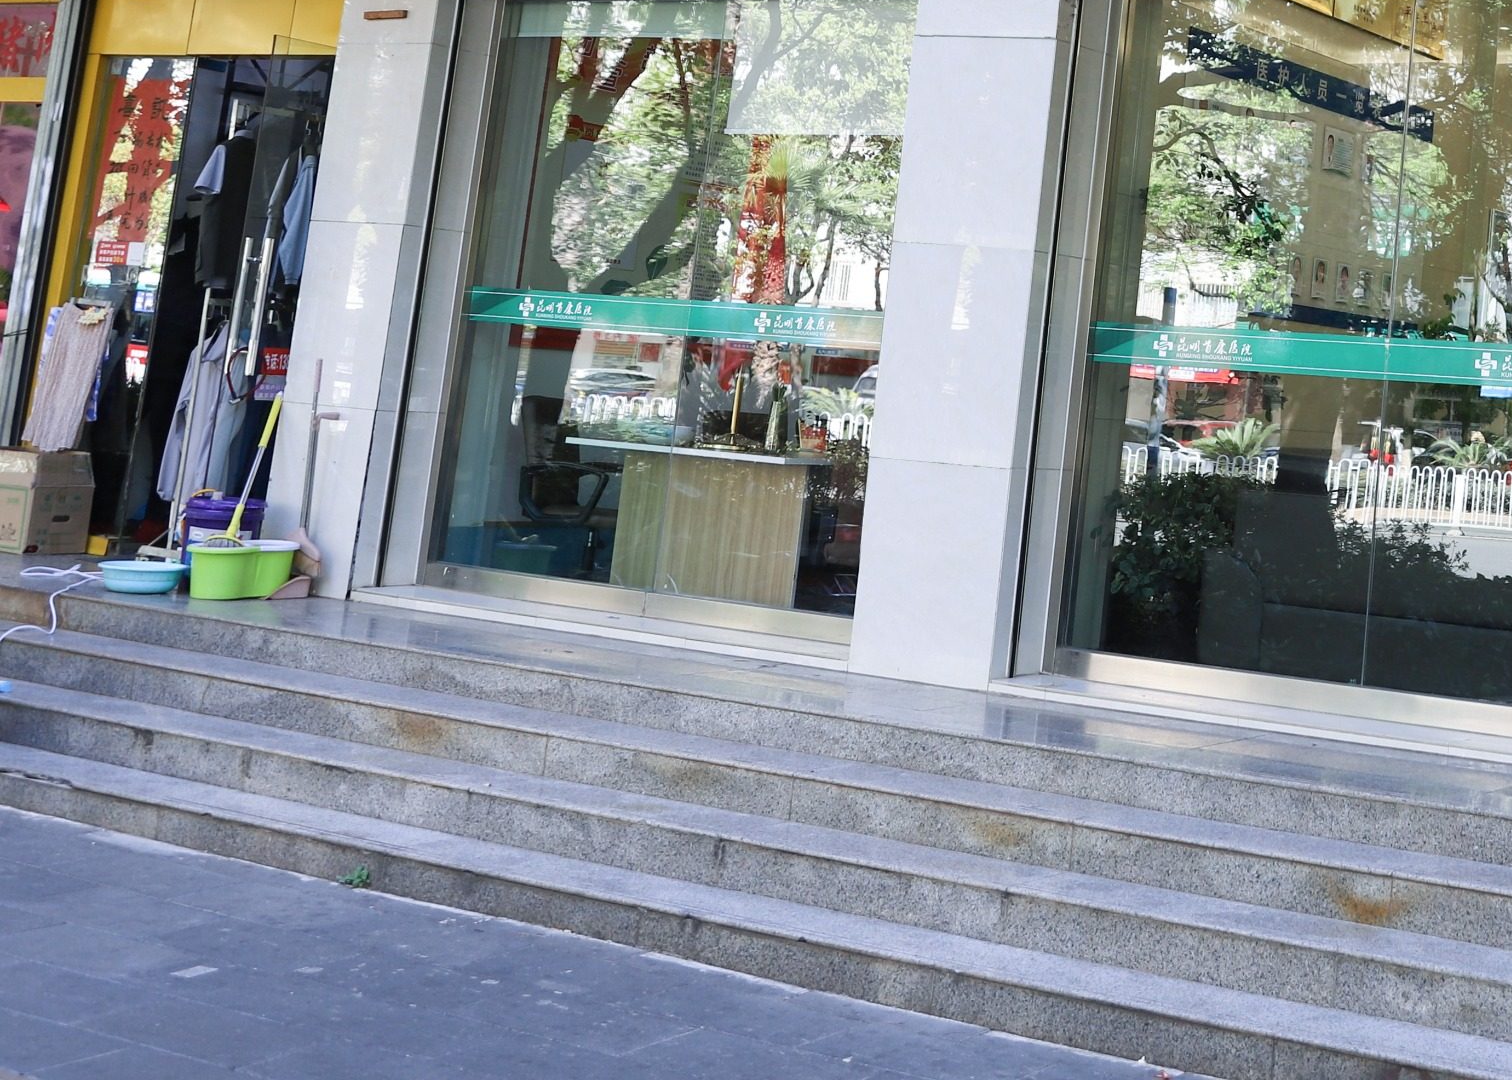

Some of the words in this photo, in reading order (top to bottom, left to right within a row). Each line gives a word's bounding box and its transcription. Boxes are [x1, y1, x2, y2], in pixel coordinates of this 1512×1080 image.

[773, 314, 837, 332] 昆明首康医院
[1177, 336, 1252, 356] 昆明首康医院
